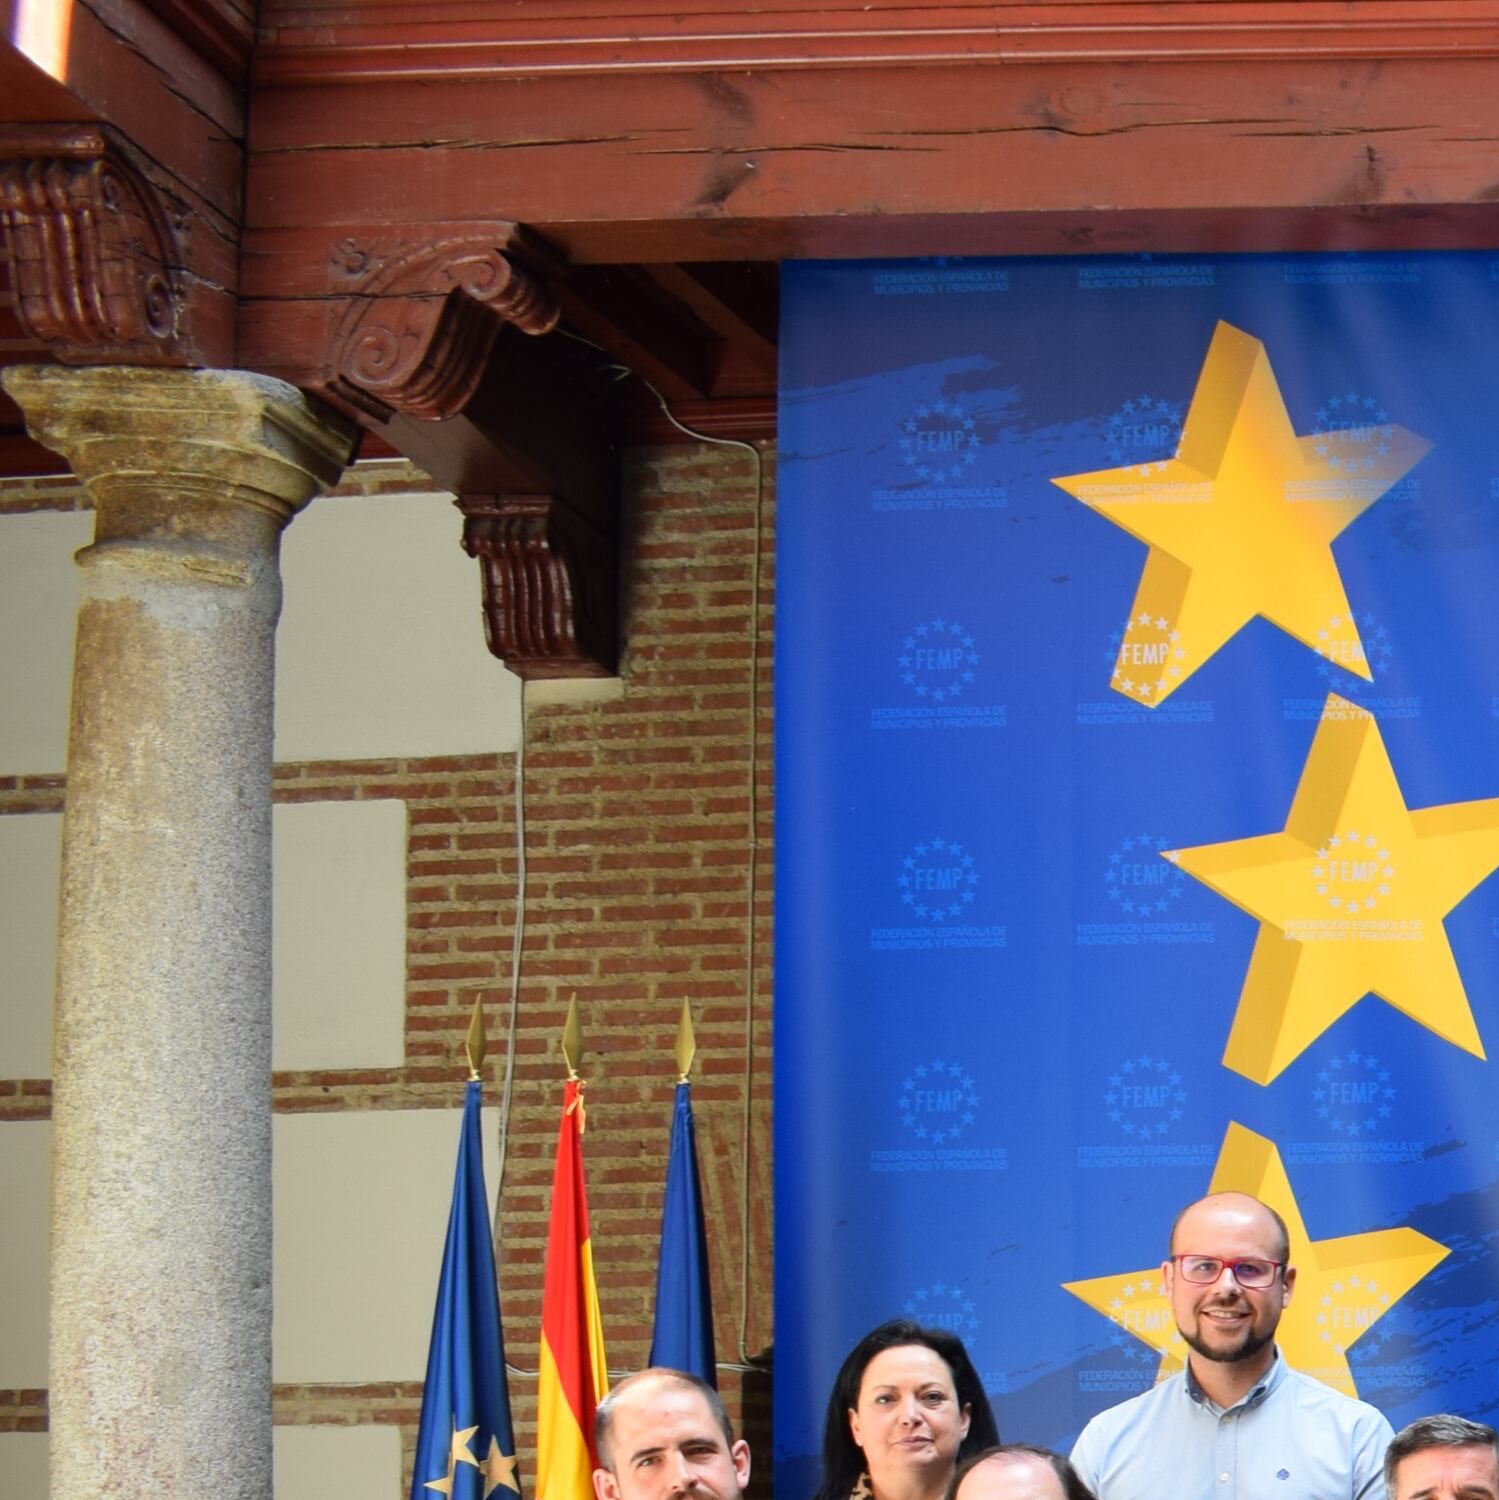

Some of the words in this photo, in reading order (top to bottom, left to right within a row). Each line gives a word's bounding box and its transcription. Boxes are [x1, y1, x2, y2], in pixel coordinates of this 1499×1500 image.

[917, 430, 964, 452] FEMP
[1122, 425, 1169, 446] FEMP
[1329, 422, 1376, 443] FEMP
[916, 648, 963, 670] FEMP
[1122, 644, 1169, 665] FEMP
[1331, 640, 1379, 662] FEMP
[915, 868, 962, 890] FEMP
[1121, 863, 1168, 885] FEMP
[1331, 861, 1379, 883] FEMP
[992, 925, 1006, 936] DE
[915, 1090, 962, 1112] FEMP
[1122, 1085, 1169, 1107] FEMP
[1331, 1082, 1378, 1104] FEMP
[1123, 1310, 1170, 1332] FEMP
[1334, 1307, 1381, 1329] FEMP
